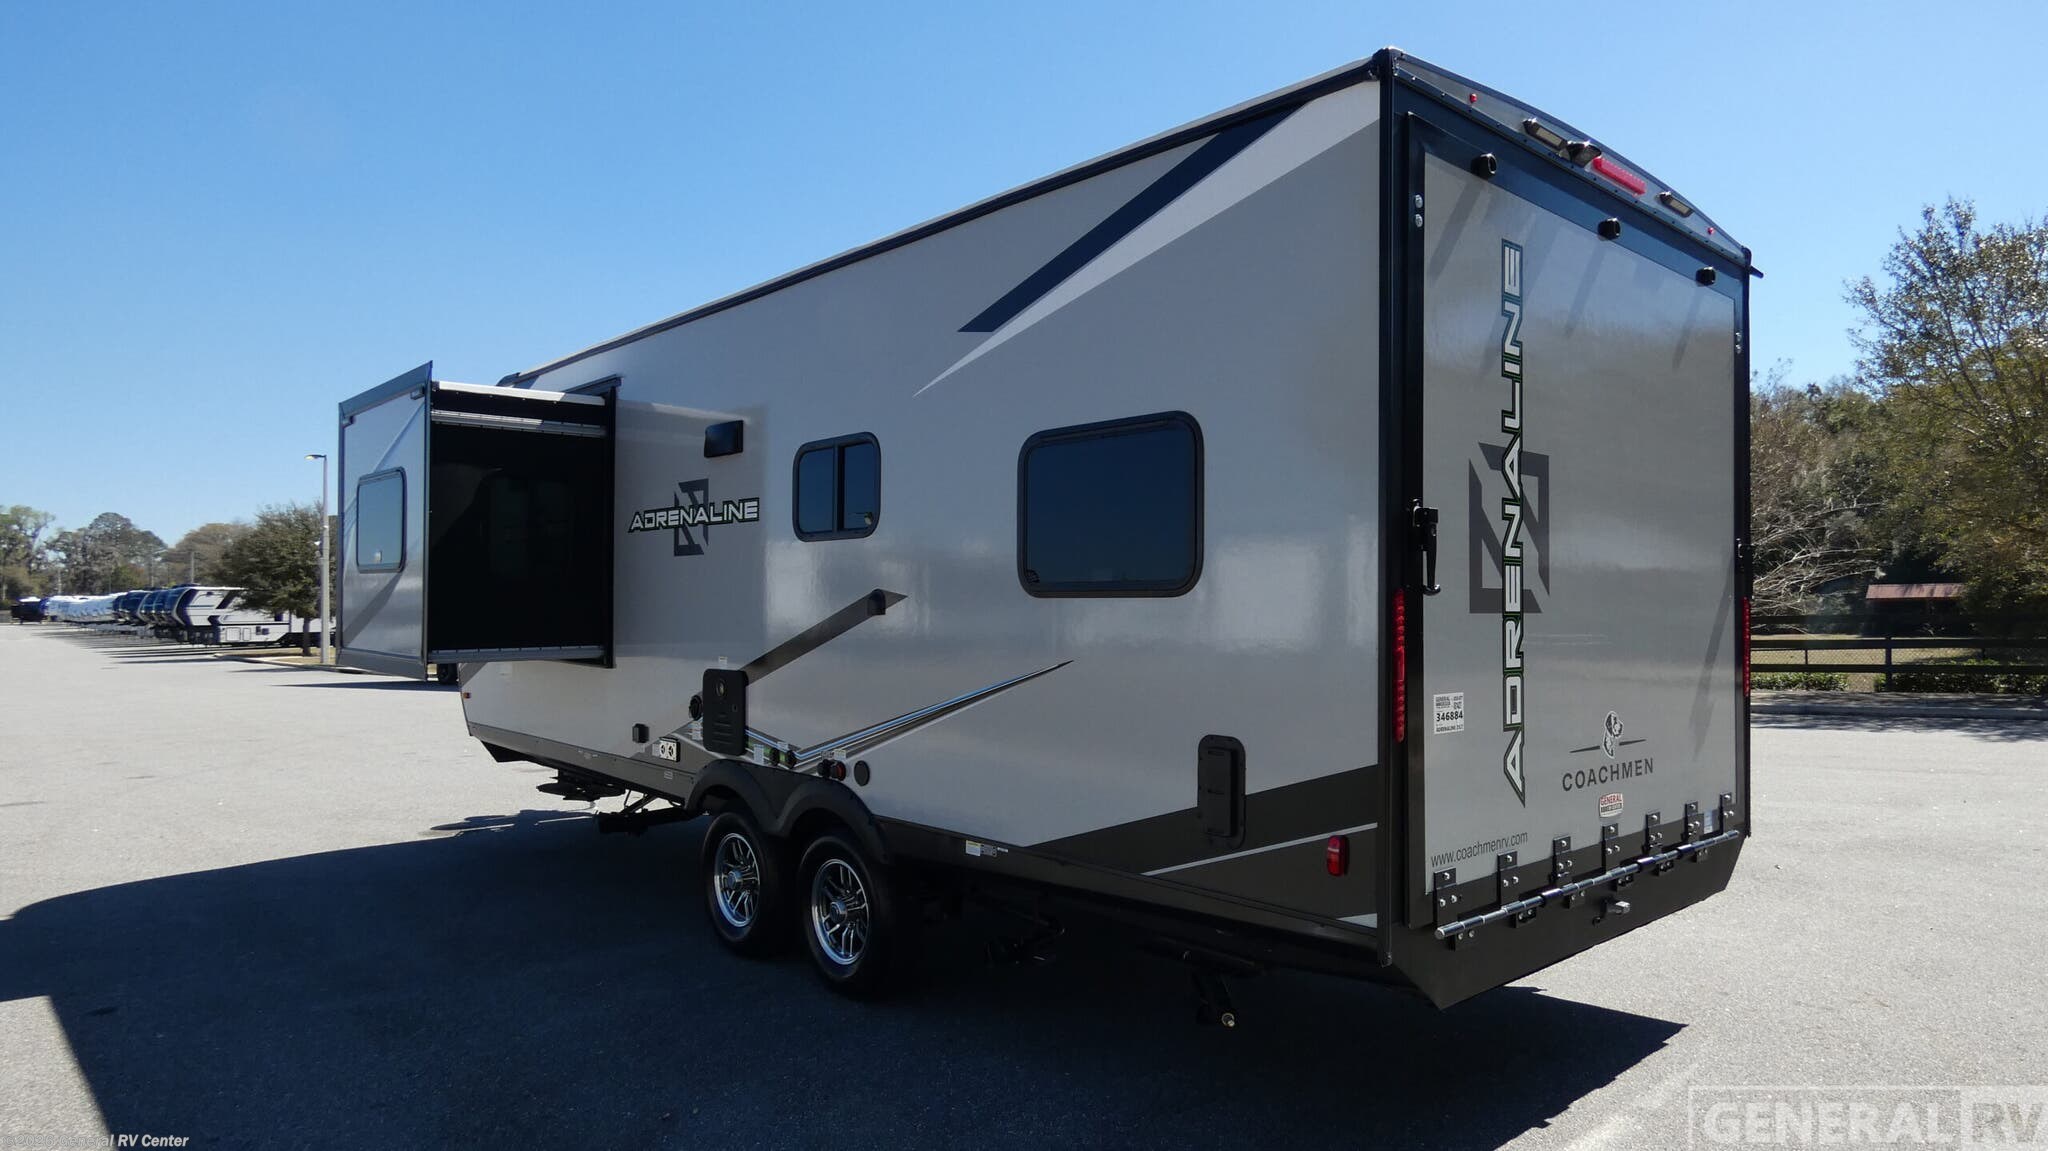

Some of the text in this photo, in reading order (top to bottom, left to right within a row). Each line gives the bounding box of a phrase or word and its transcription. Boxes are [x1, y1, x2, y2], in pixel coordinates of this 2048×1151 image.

[628, 497, 760, 533] ADRENALINE
[1501, 238, 1526, 808] ADRENALINE
[1436, 710, 1463, 722] 346884
[1562, 758, 1653, 792] COACHMEN
[1431, 832, 1528, 868] www.coachmenrv.com
